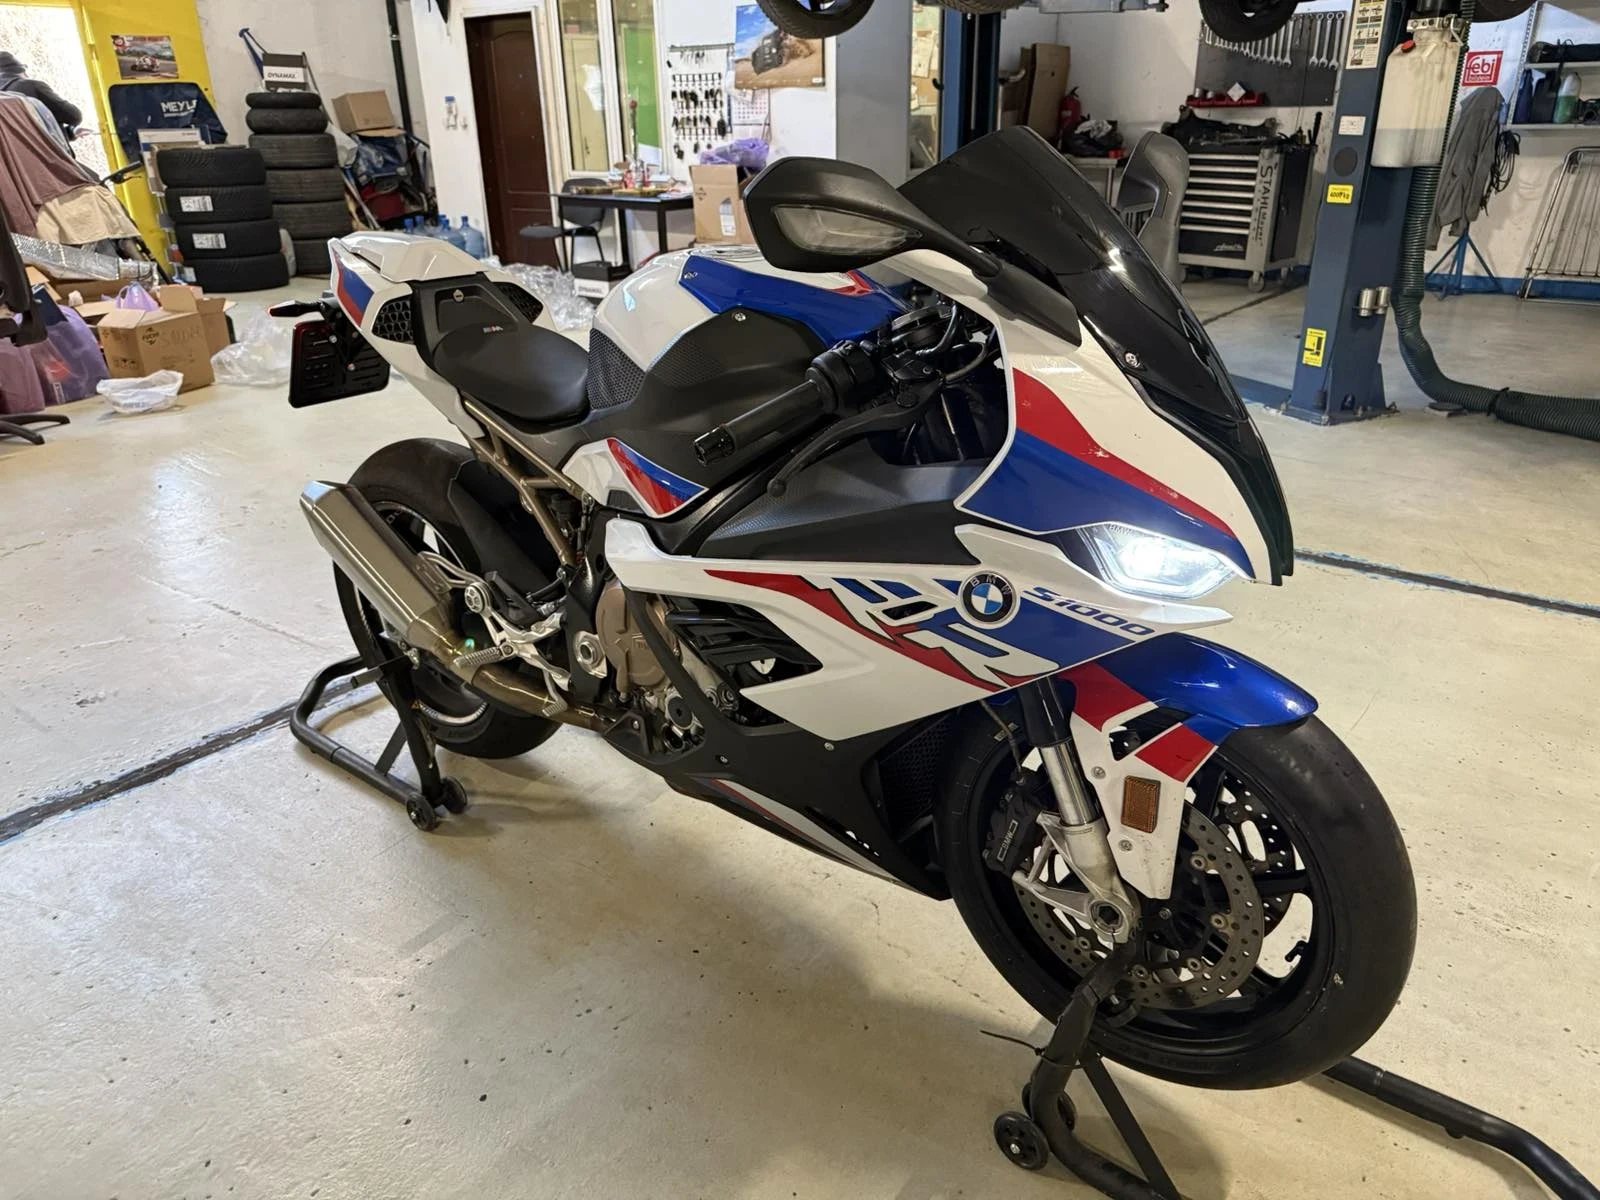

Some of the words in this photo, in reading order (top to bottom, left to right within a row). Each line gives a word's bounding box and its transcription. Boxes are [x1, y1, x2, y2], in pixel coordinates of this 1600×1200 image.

[1465, 56, 1496, 81] febi
[970, 575, 1011, 595] BMW
[1022, 586, 1156, 636] S1000
